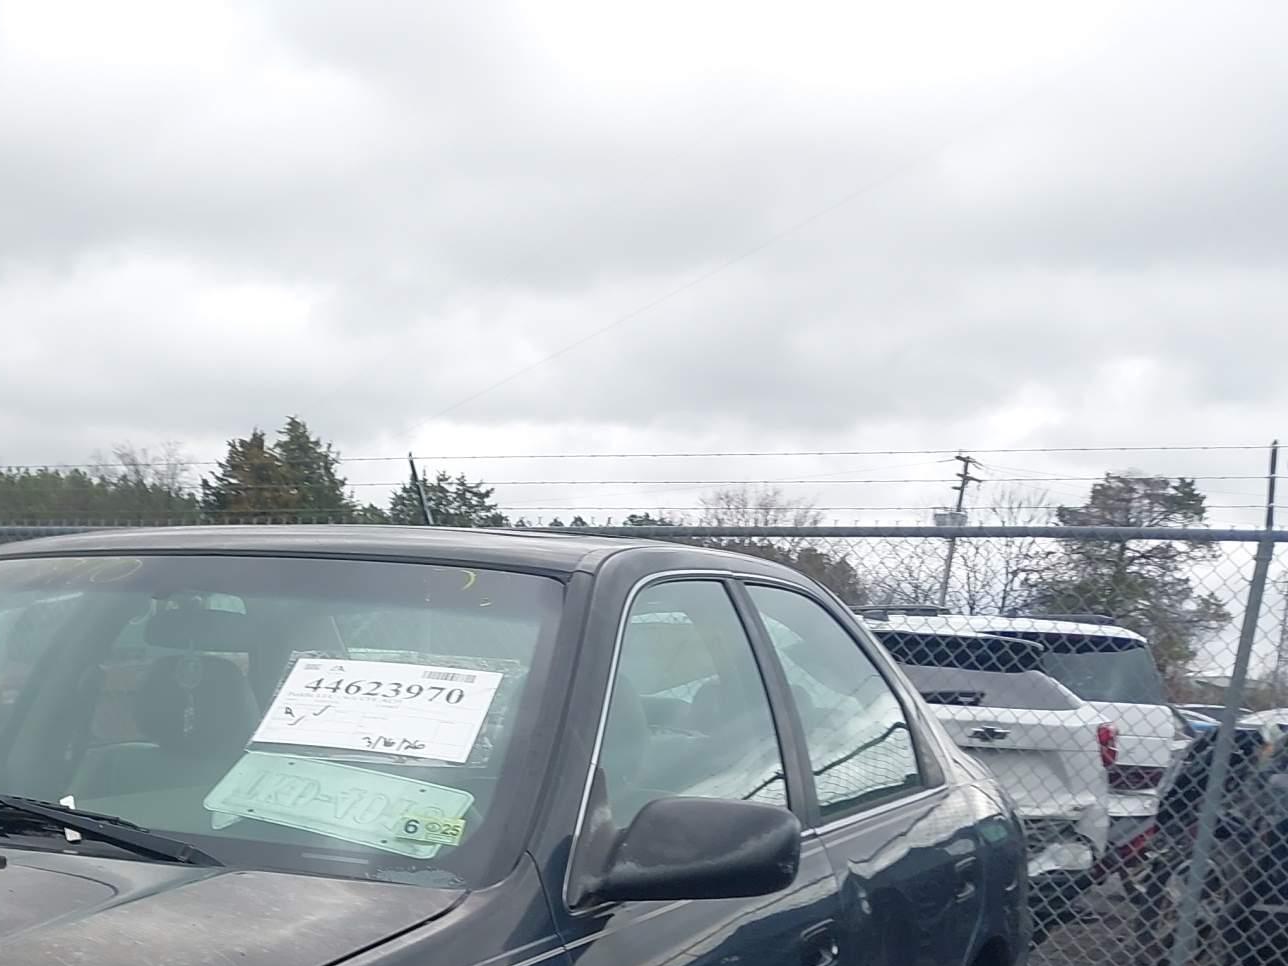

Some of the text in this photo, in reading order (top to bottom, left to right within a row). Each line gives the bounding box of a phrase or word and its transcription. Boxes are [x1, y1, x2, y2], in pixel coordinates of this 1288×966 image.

[304, 677, 465, 705] 44623970
[404, 819, 460, 837] 6 25
